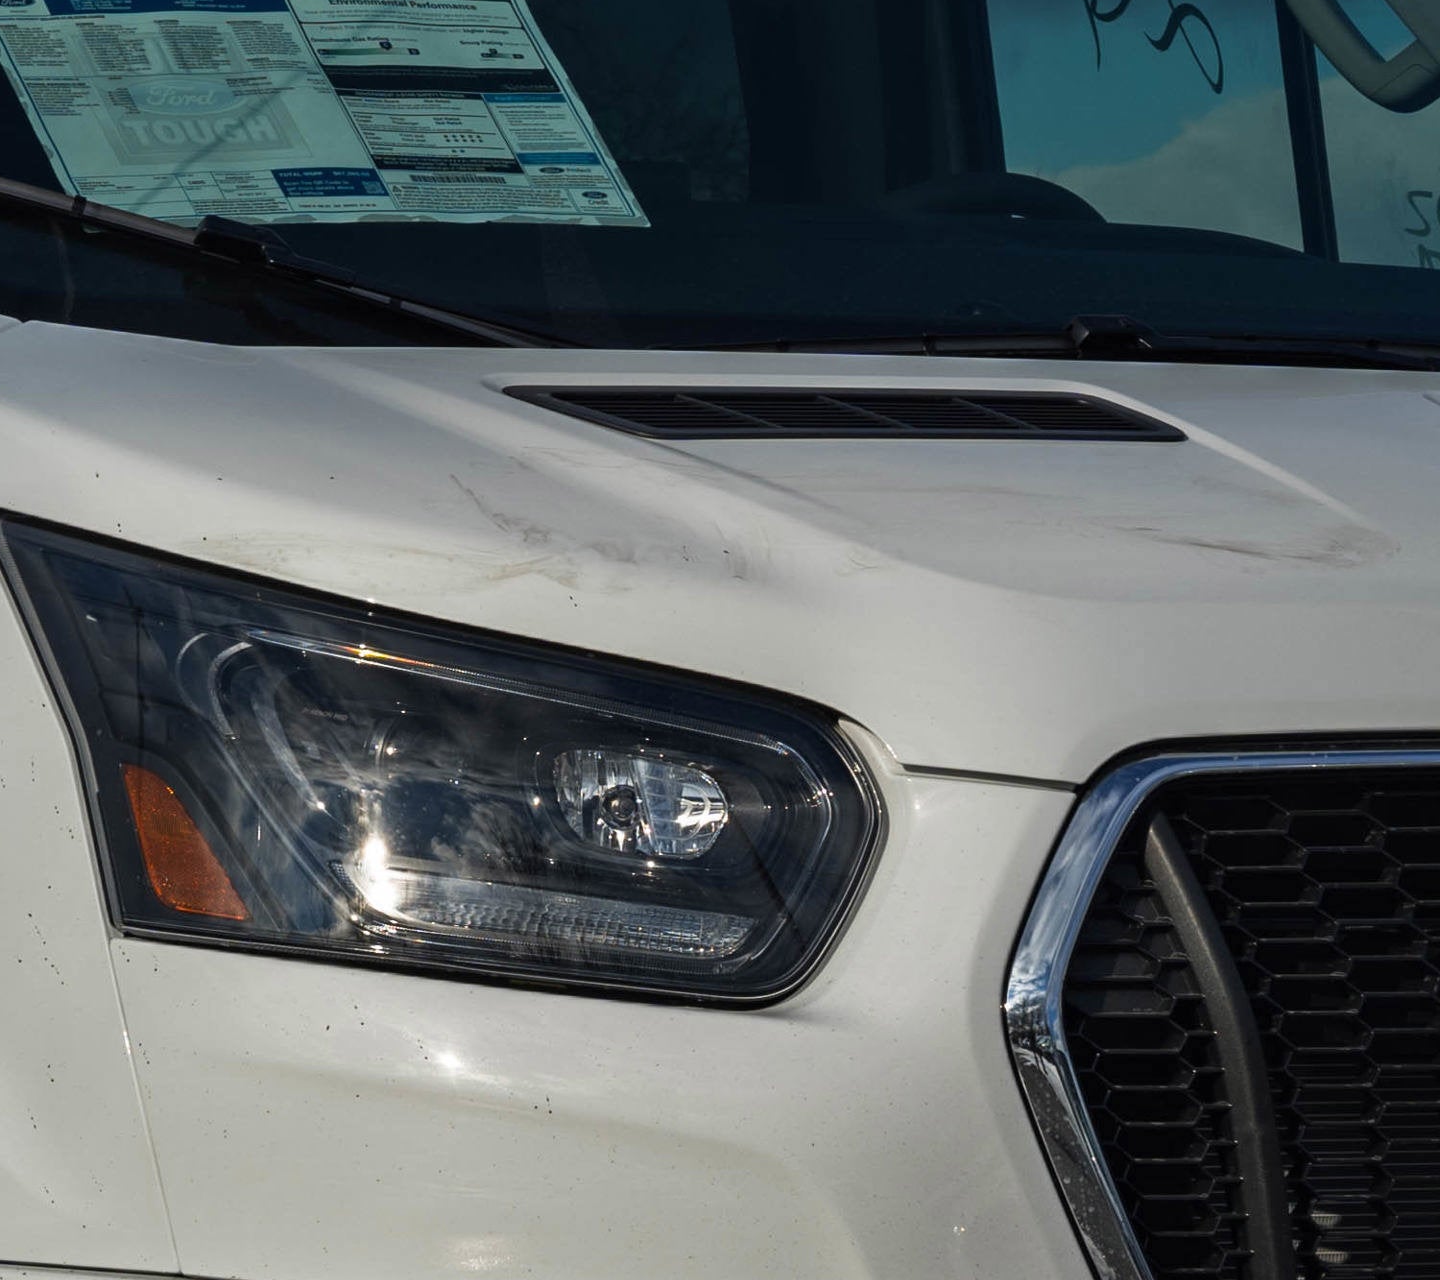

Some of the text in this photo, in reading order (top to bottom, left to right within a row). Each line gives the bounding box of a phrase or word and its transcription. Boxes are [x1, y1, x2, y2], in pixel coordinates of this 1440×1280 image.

[409, 0, 477, 10] Performance
[147, 85, 214, 106] Ford
[121, 115, 281, 146] TOUGH
